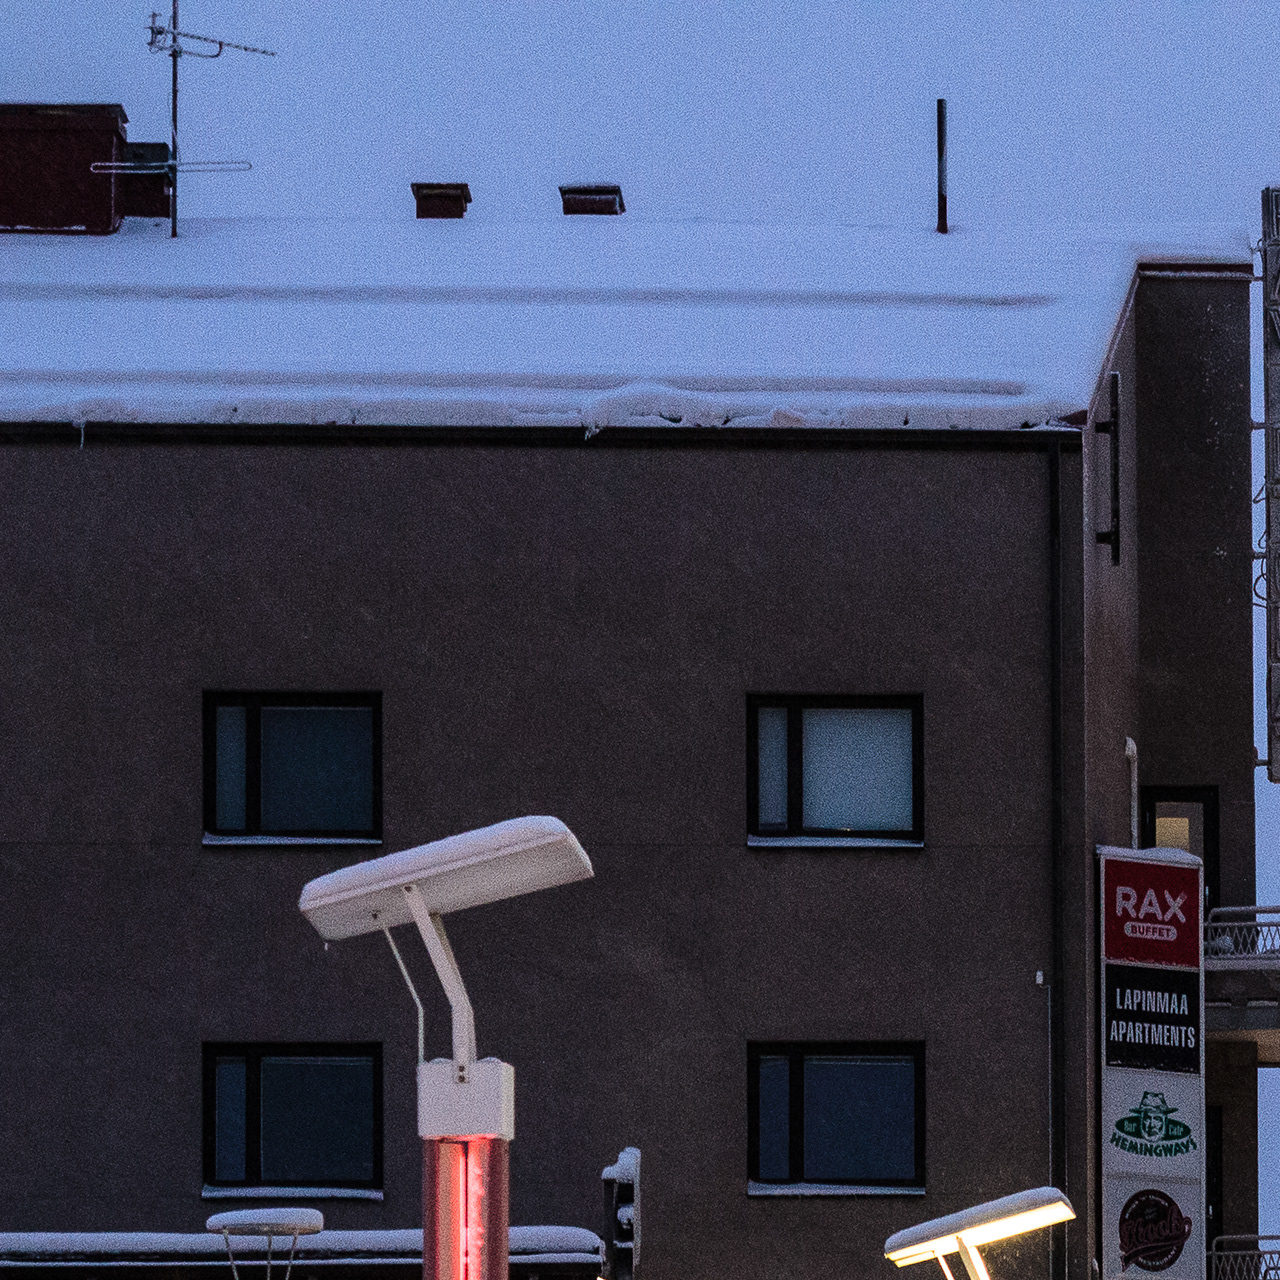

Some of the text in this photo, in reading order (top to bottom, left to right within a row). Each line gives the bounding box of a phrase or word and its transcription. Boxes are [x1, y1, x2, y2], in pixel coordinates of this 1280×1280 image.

[1116, 886, 1187, 923] RAX
[1130, 926, 1172, 937] BUFFET
[1116, 988, 1188, 1015] LAPINMAA
[1110, 1020, 1195, 1048] APARTMENTS
